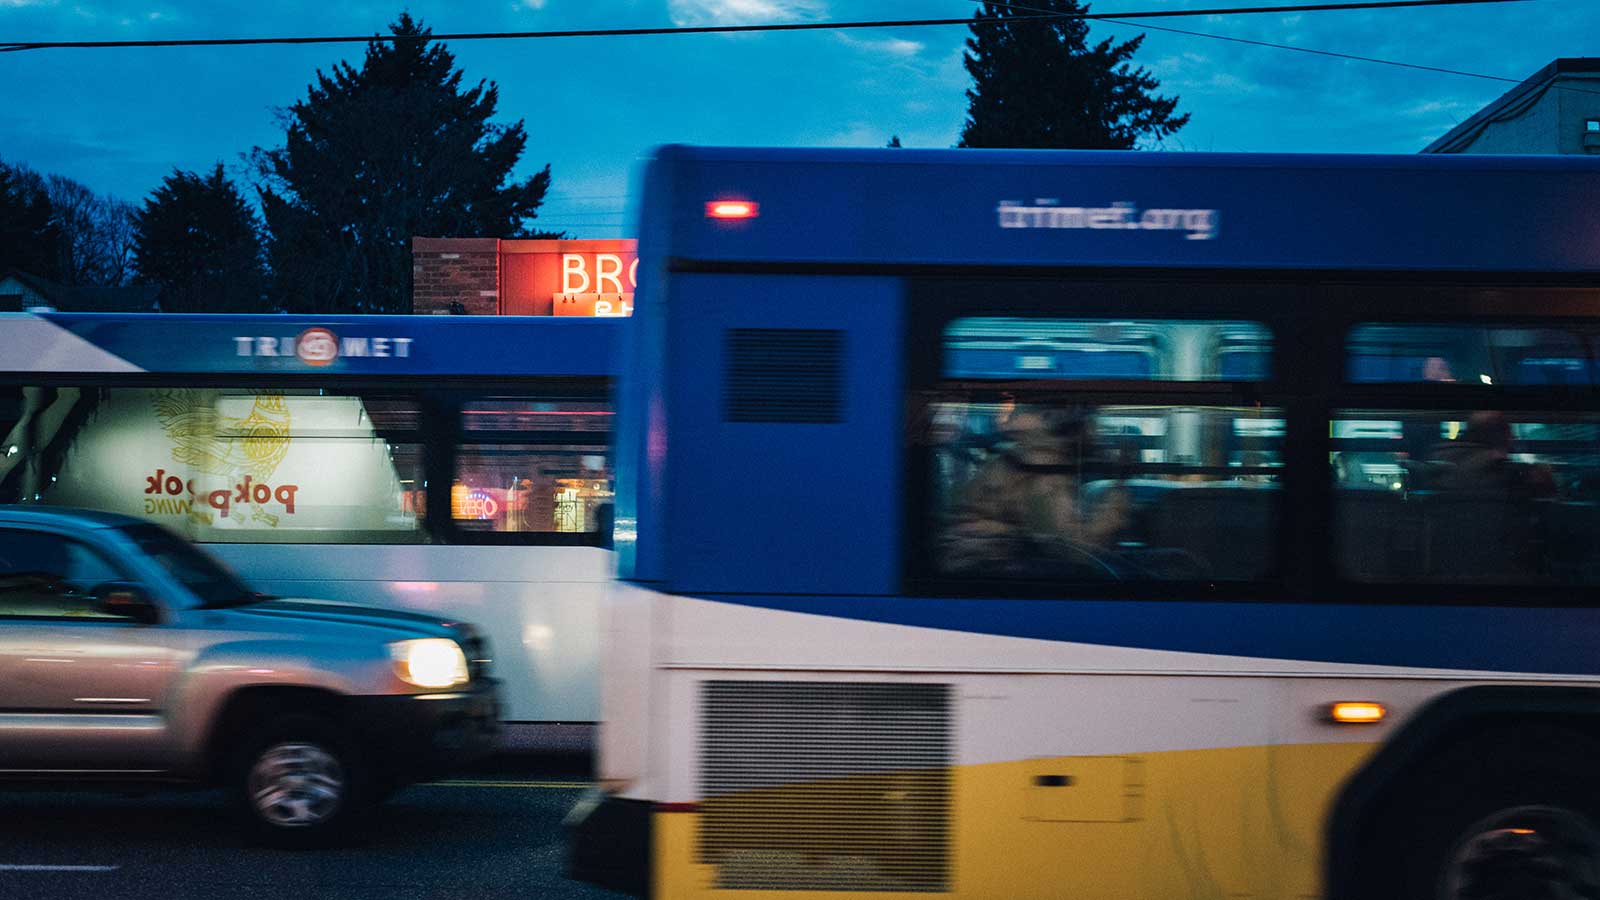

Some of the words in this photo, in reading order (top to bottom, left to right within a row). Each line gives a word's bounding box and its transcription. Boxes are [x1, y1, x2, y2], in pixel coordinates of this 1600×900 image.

[997, 199, 1218, 240] trimet.org
[563, 254, 639, 294] BR
[233, 336, 297, 357] TRI
[341, 337, 413, 358] MET
